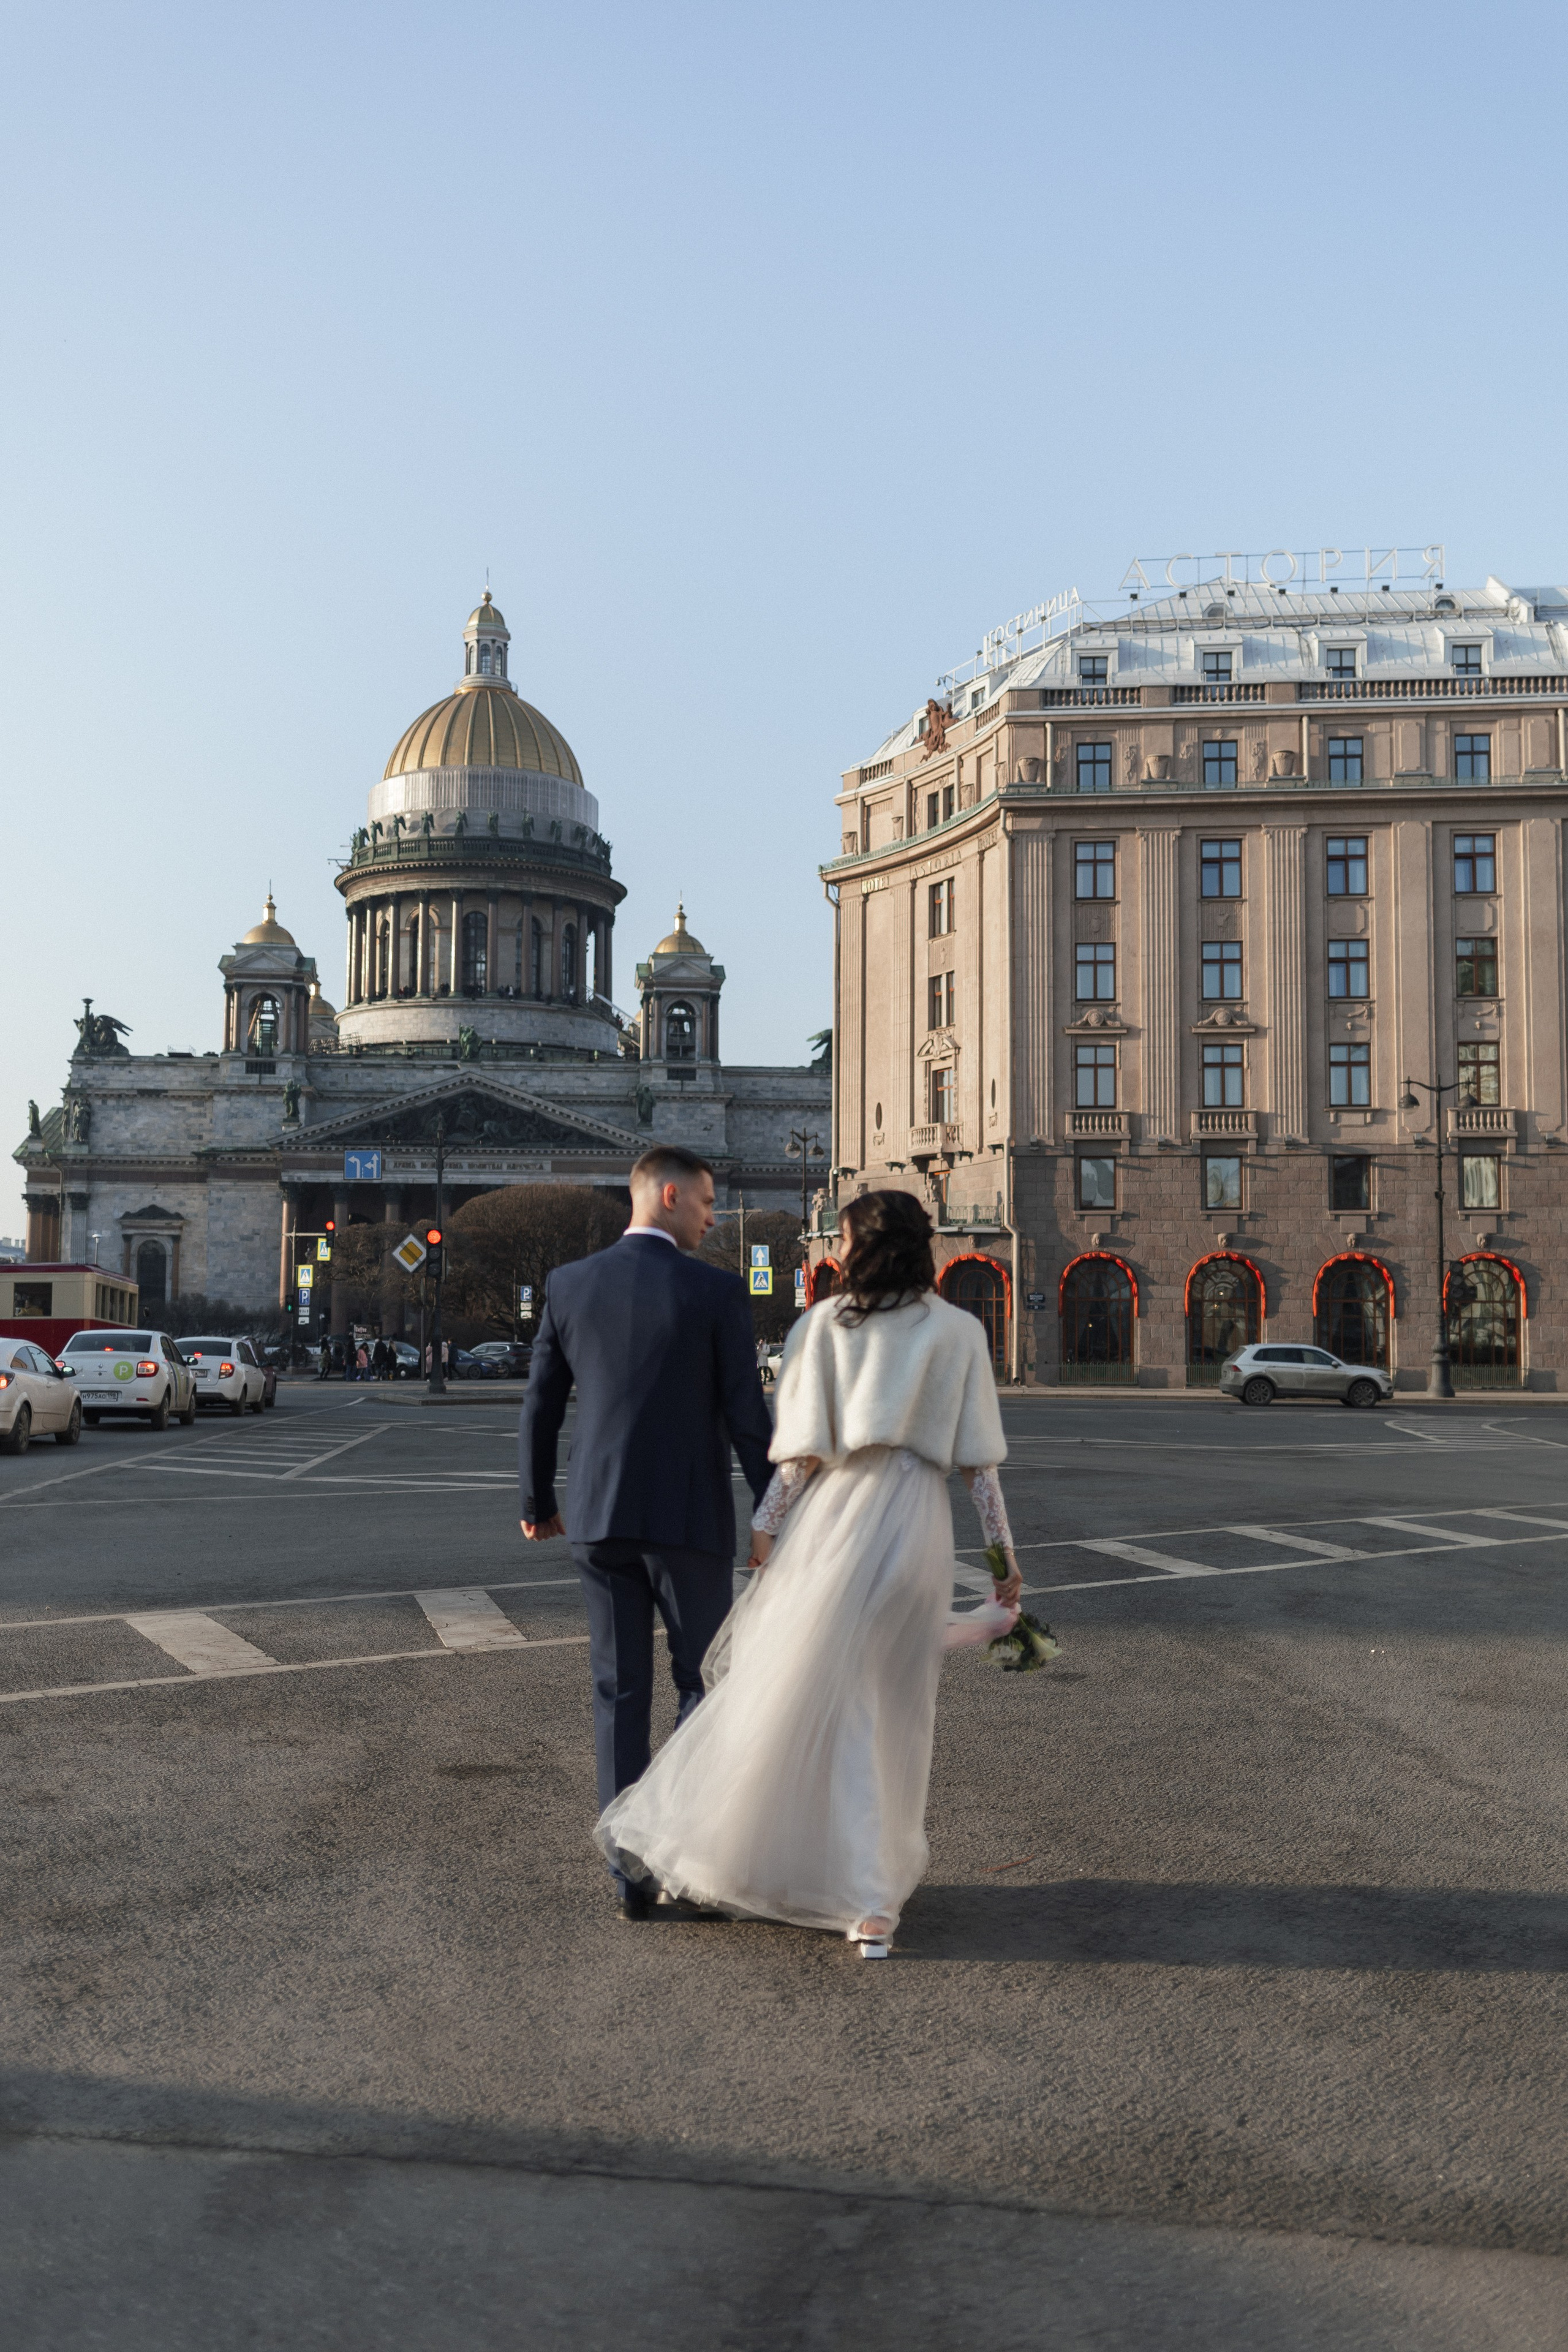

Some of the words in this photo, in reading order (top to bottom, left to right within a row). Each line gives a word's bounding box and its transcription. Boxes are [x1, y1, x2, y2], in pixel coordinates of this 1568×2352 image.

[1118, 543, 1446, 591] АСТОРИЯ
[987, 586, 1080, 648] ГОСТИНИЦА
[119, 1365, 129, 1376] P
